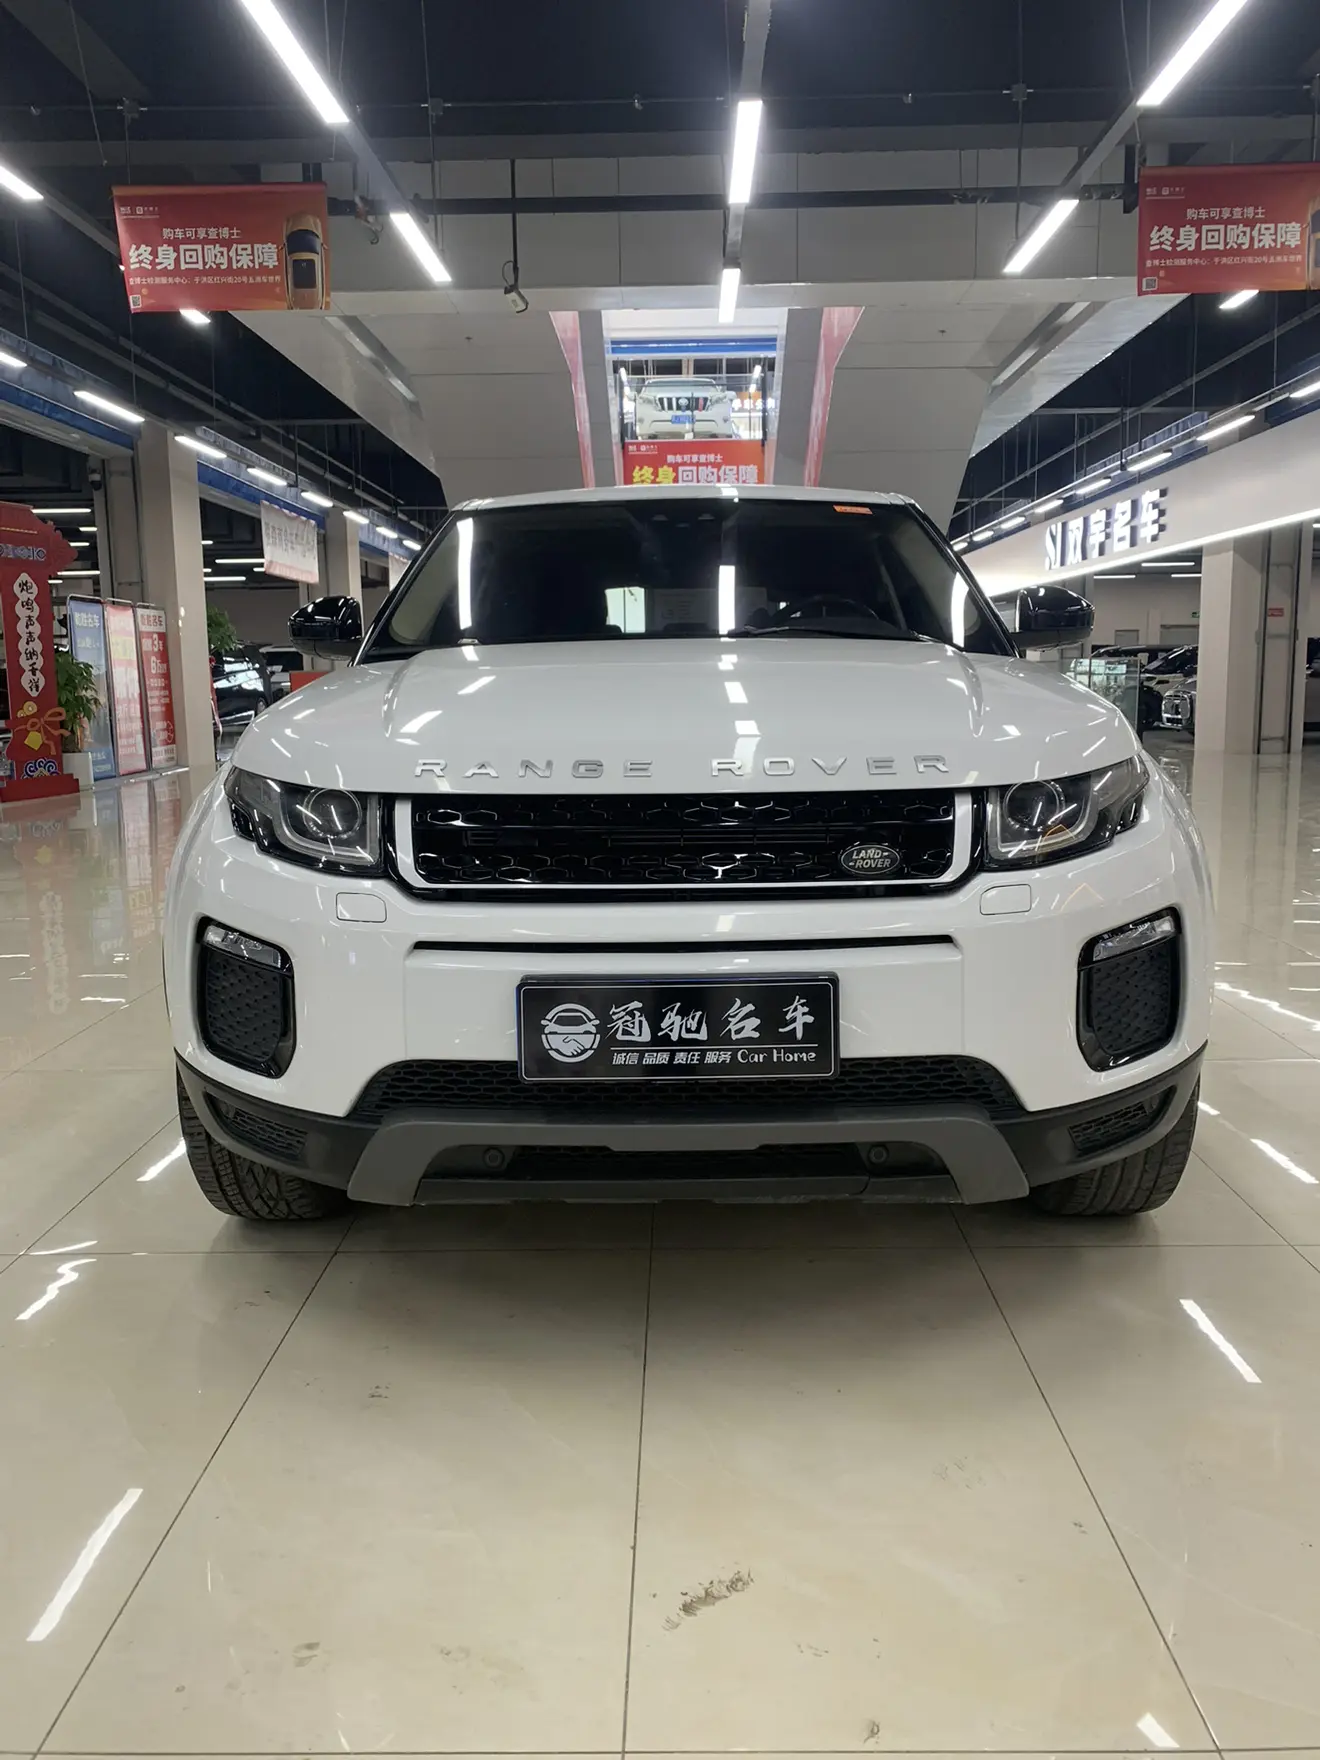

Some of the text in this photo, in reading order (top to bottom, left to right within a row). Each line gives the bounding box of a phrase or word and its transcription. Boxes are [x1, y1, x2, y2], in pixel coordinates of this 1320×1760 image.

[1186, 206, 1266, 220] 购车可享查博士
[162, 226, 241, 240] 购车可享查博士
[1149, 221, 1302, 252] 终身回购保障
[128, 243, 279, 270] 终身回购保障
[632, 464, 759, 484] 终身回购保障
[414, 755, 949, 778] RANGE ROVER
[852, 849, 882, 859] LAND
[855, 859, 892, 869] ROVER
[605, 995, 815, 1042] 冠驰名车
[612, 1048, 816, 1065] 诚信 品质 责任 服务 Car Home
